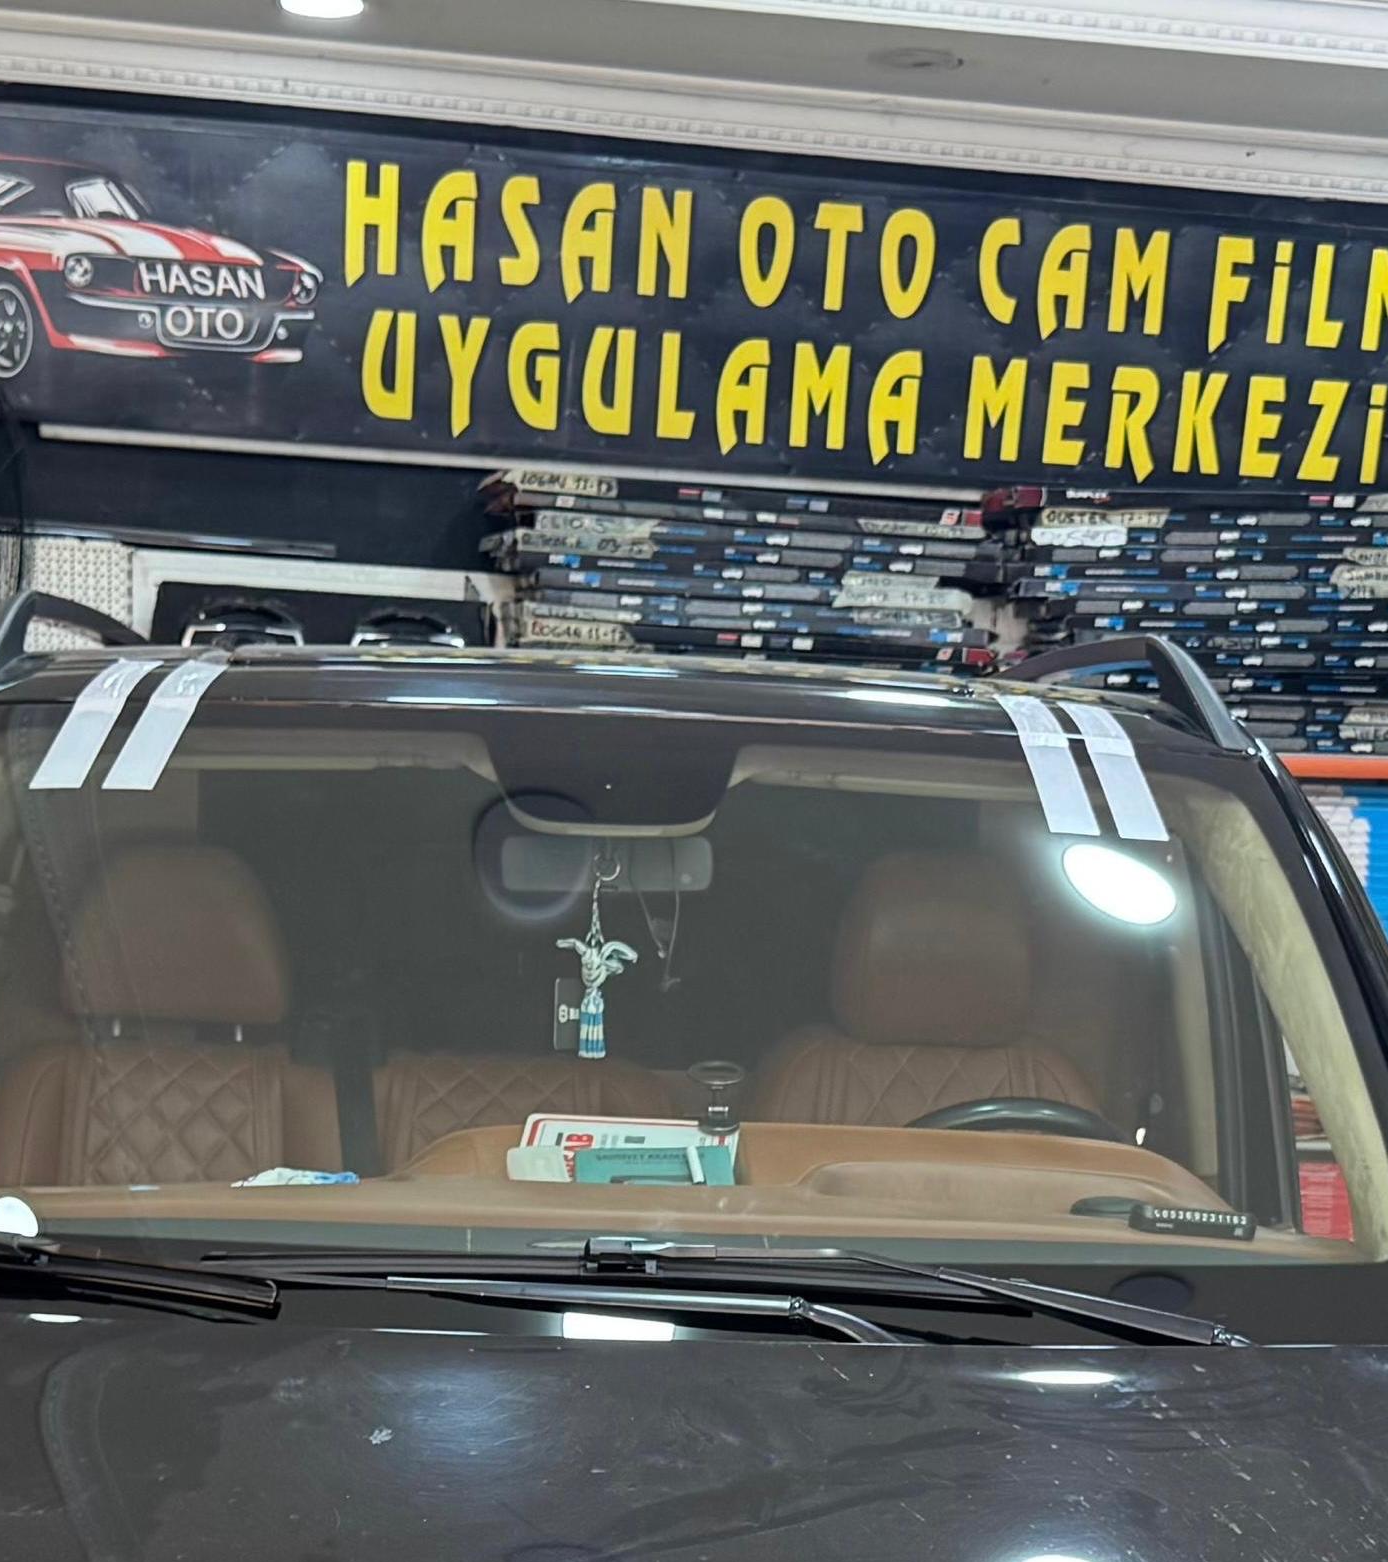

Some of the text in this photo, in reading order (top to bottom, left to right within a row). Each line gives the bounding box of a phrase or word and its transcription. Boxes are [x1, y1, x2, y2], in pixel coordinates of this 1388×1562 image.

[137, 259, 267, 301] HASAN
[345, 161, 694, 301] HASAN
[740, 196, 937, 319] OTO
[979, 217, 1172, 338] CAM
[163, 304, 246, 340] OTO
[362, 310, 924, 463] UYGULAMA
